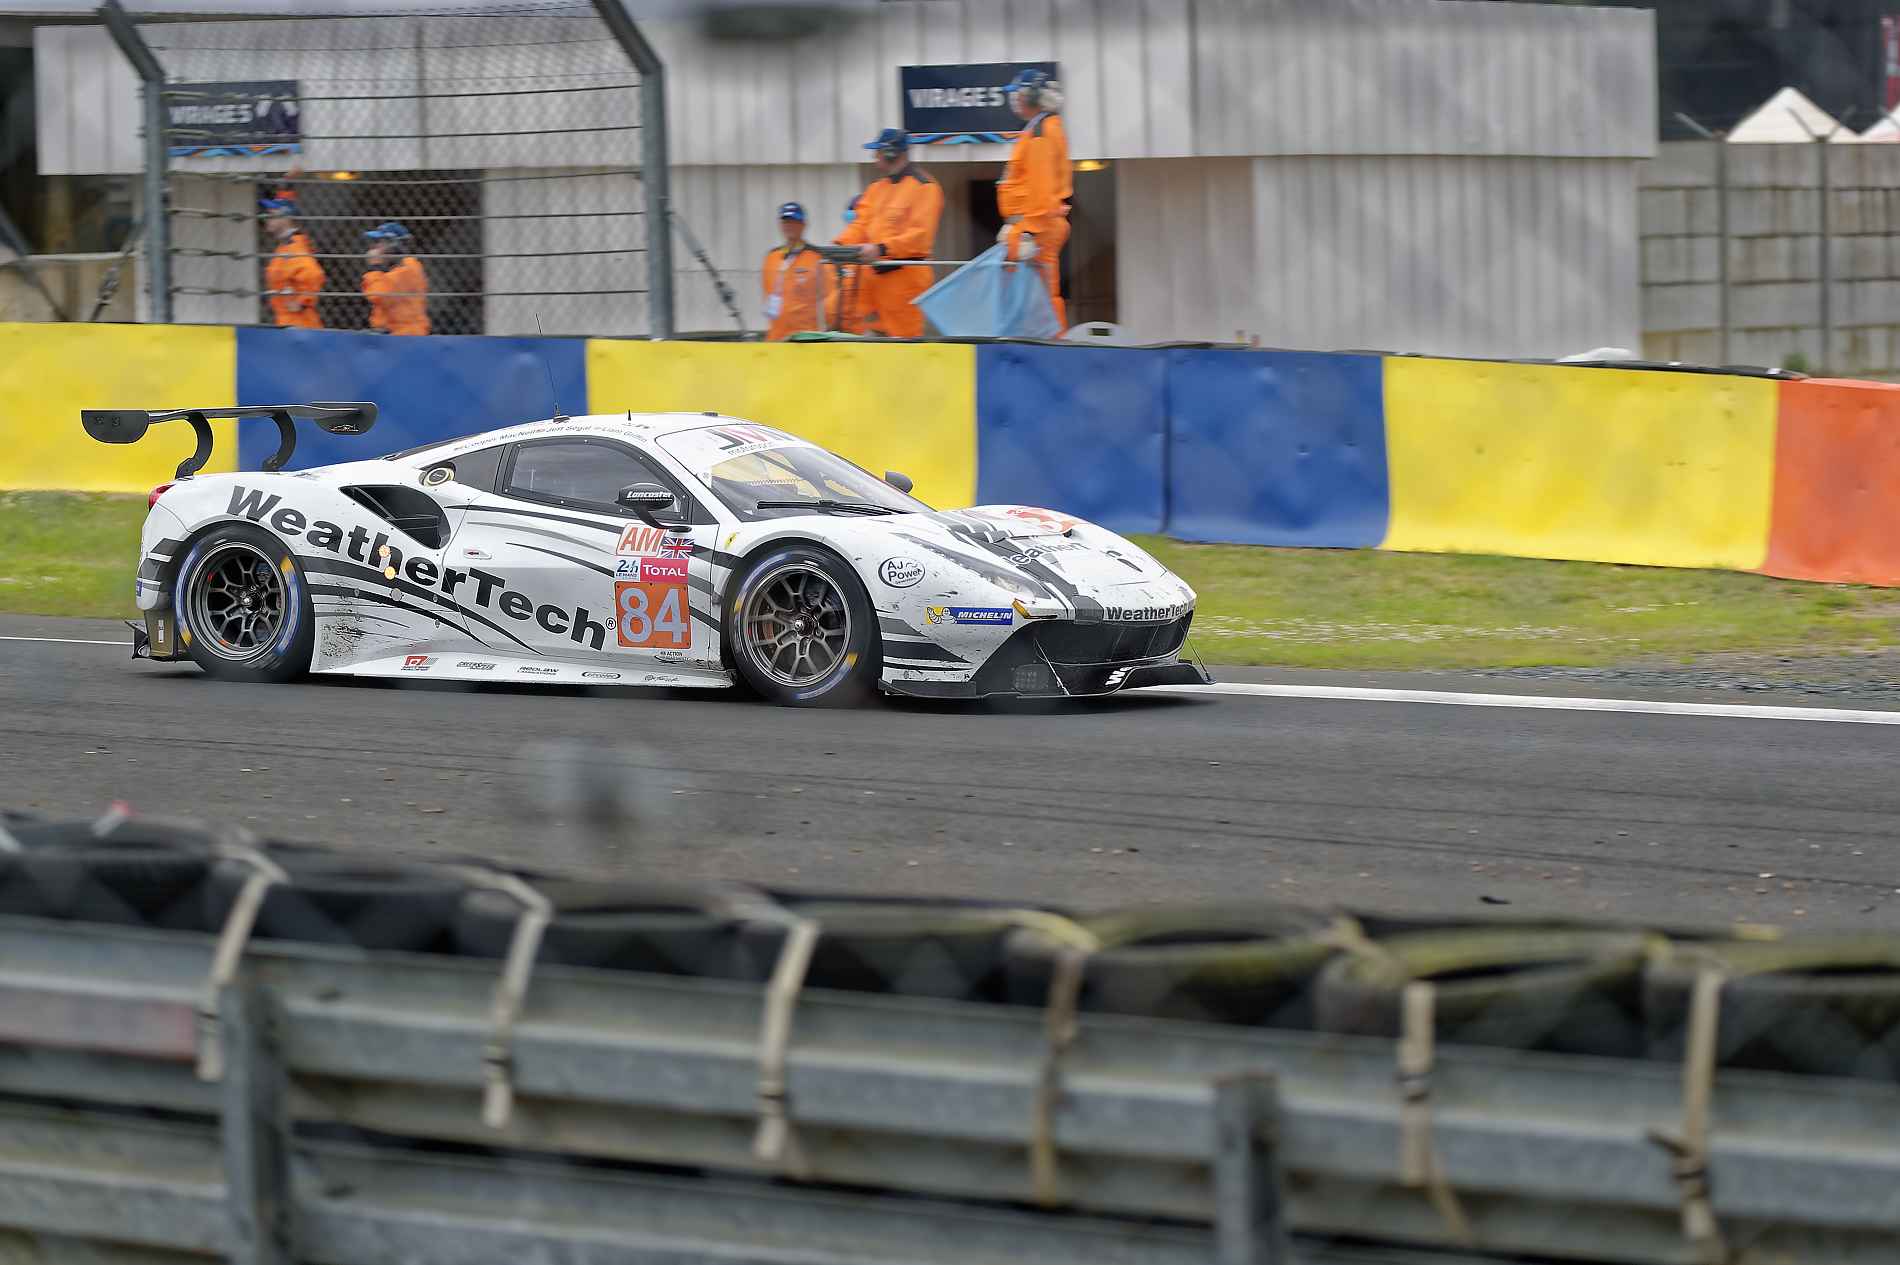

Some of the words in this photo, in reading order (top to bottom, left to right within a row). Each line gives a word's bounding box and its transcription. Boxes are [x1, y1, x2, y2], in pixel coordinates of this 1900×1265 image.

[619, 527, 664, 552] AM
[887, 560, 904, 571] AJ
[888, 568, 923, 582] Power
[620, 587, 689, 644] 84
[957, 611, 1013, 619] MICHELIN
